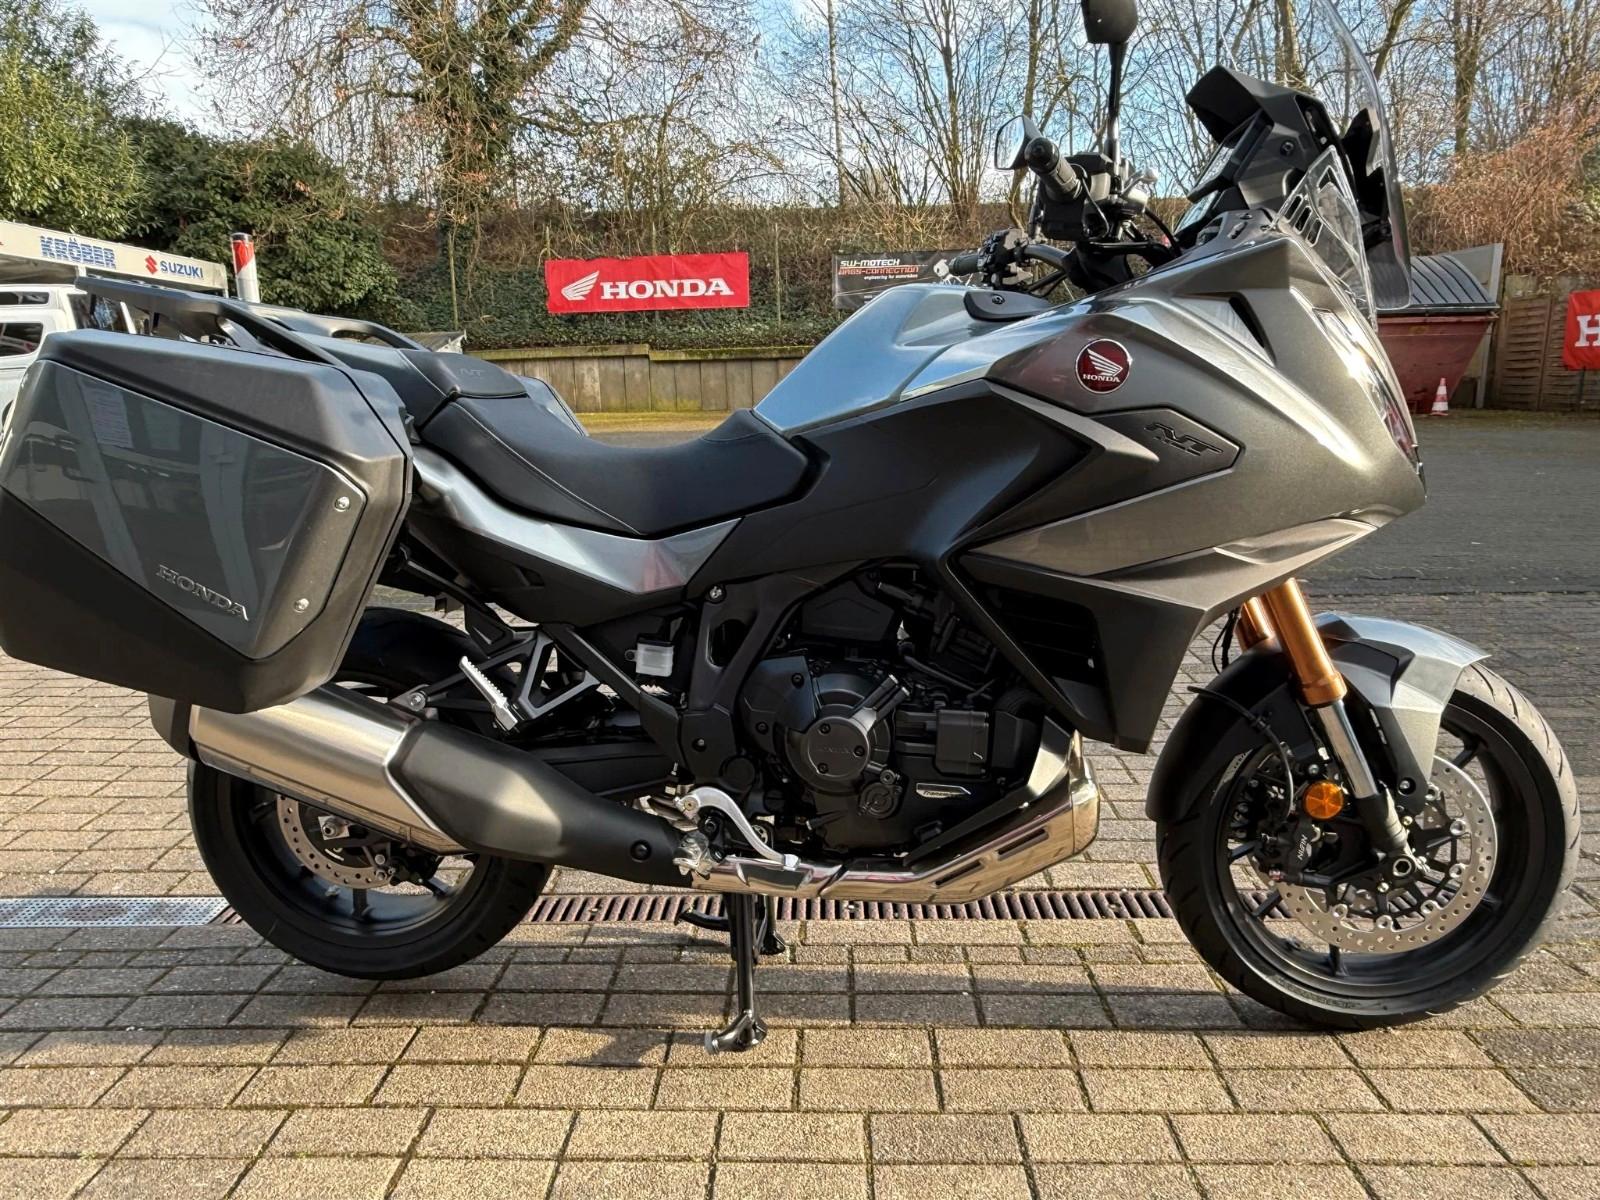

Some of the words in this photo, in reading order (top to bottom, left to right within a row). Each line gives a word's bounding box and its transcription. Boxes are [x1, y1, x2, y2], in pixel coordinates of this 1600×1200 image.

[160, 261, 203, 279] SUZUKI
[840, 259, 900, 267] SW-MOTECH
[601, 278, 734, 299] HONDA
[1082, 373, 1120, 383] HONDA
[156, 564, 249, 621] HONDA
